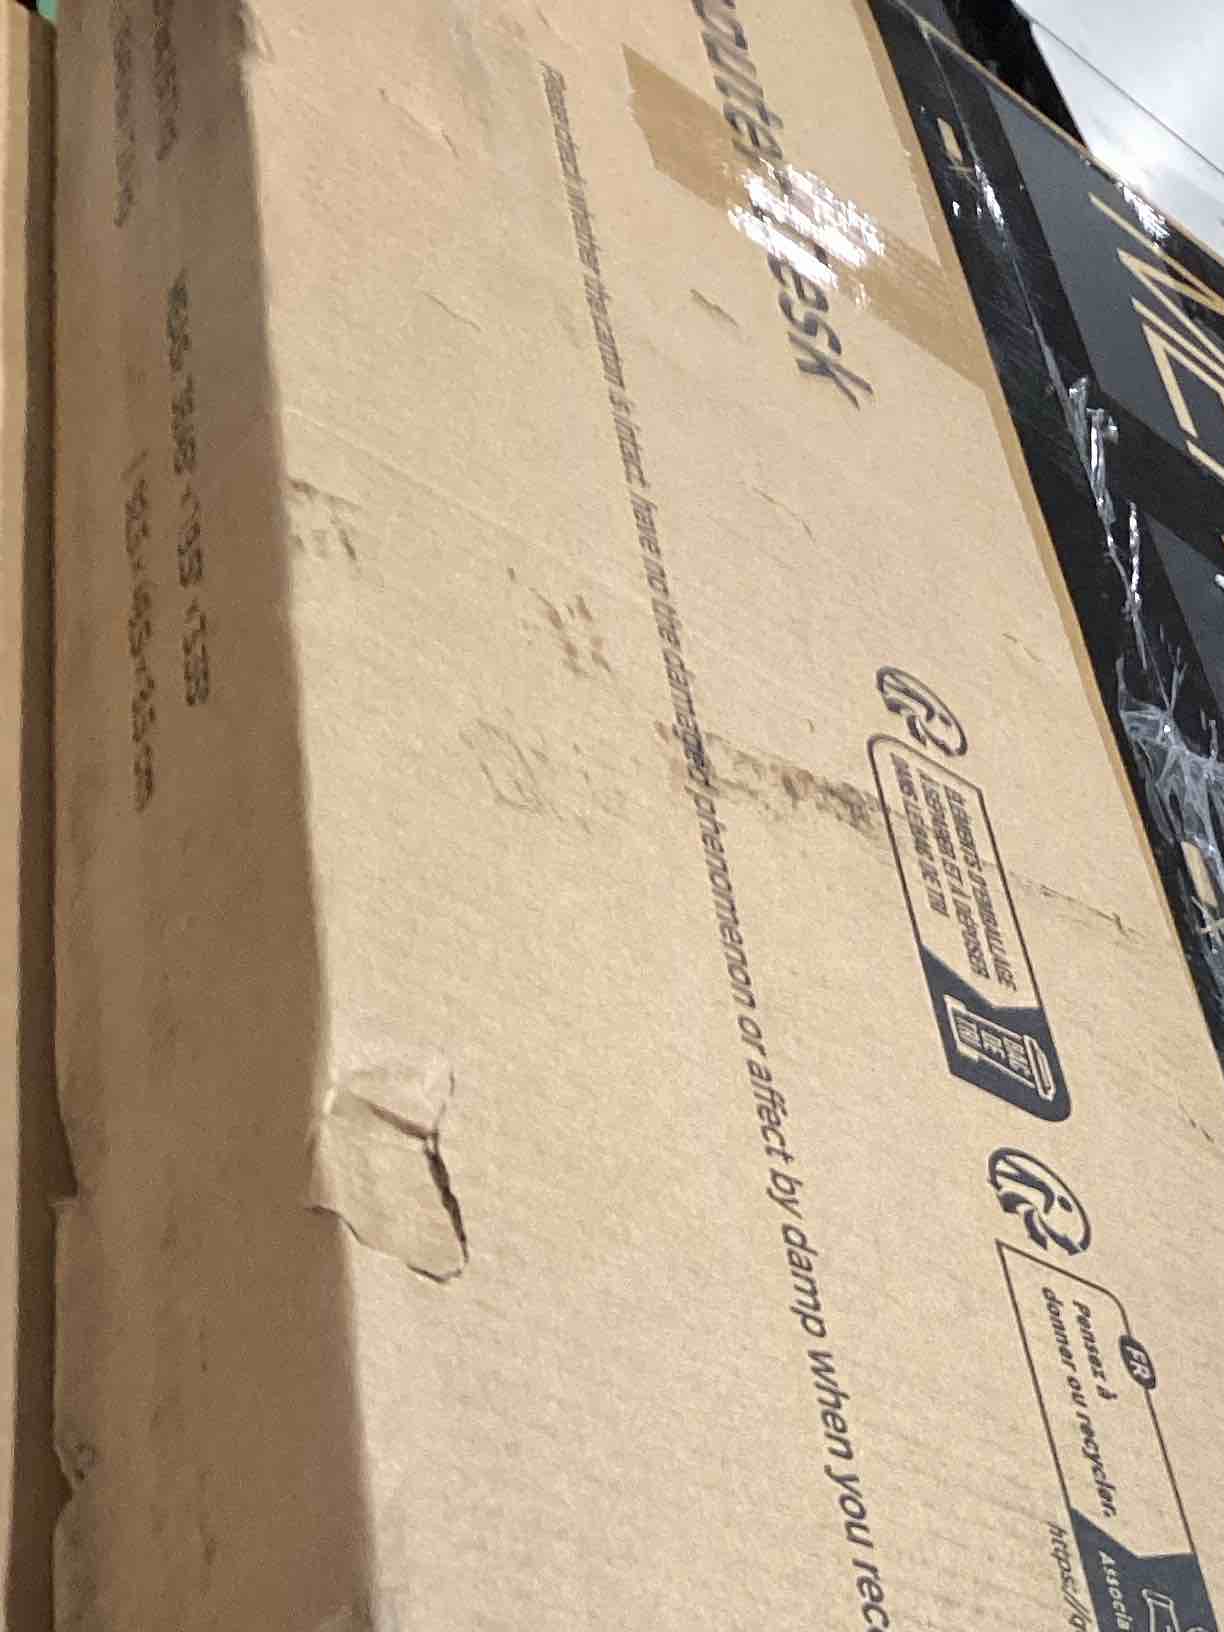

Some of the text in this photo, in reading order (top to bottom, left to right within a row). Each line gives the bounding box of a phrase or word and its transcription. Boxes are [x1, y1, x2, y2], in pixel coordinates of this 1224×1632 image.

[628, 492, 660, 556] have
[647, 555, 670, 600] no
[650, 600, 683, 648] the
[660, 648, 720, 797] damaged
[684, 787, 757, 1008] phenomenon
[735, 1015, 765, 1056] or
[745, 1059, 792, 1163] affect
[764, 1167, 805, 1219] by
[779, 1222, 830, 1338] damp
[1072, 1300, 1116, 1400] Pensez à
[1124, 1346, 1149, 1378] FR
[805, 1349, 858, 1460] when
[1041, 1287, 1118, 1518] donner ou recycler.
[824, 1465, 873, 1549] you
